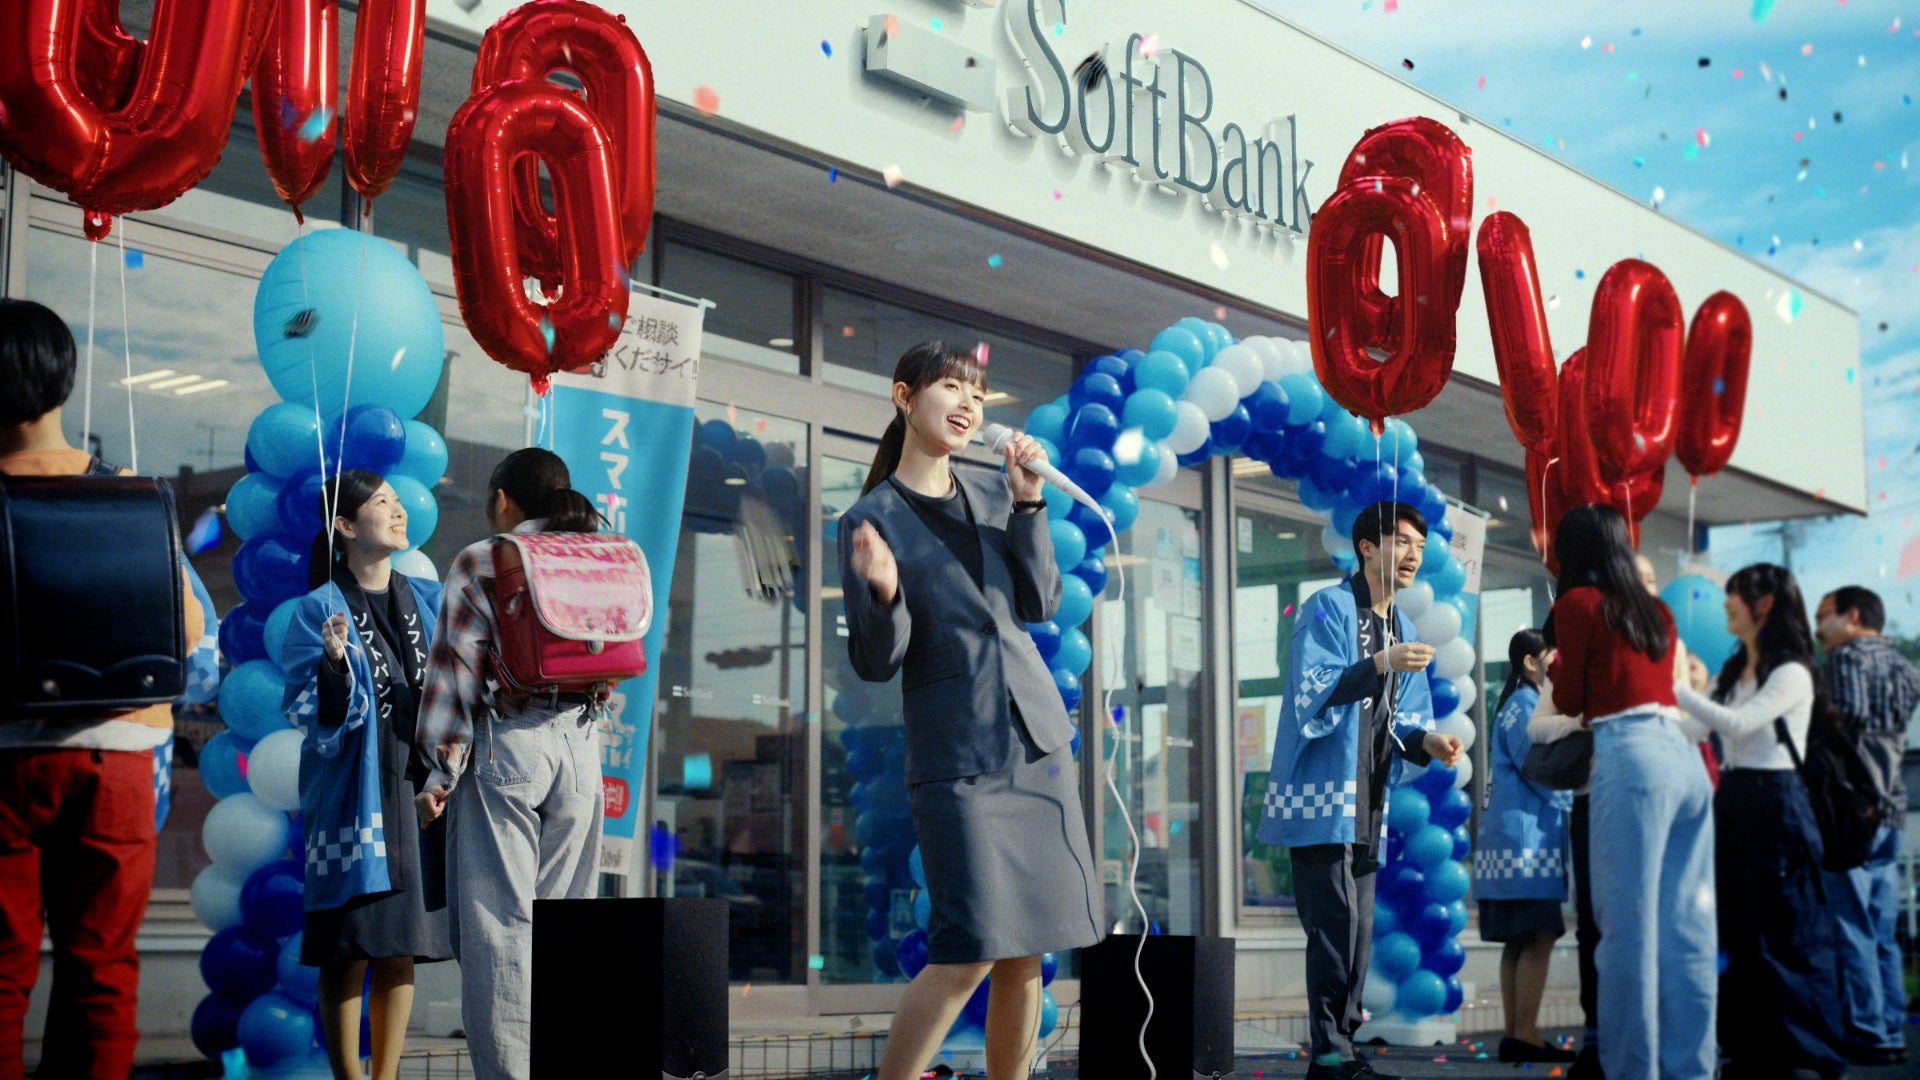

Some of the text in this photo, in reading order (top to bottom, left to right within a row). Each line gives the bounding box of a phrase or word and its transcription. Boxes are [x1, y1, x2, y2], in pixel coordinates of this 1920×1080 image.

[1024, 0, 1314, 234] SoftBank
[353, 612, 393, 719] ソフトバンク
[403, 612, 426, 691] ソフトバ
